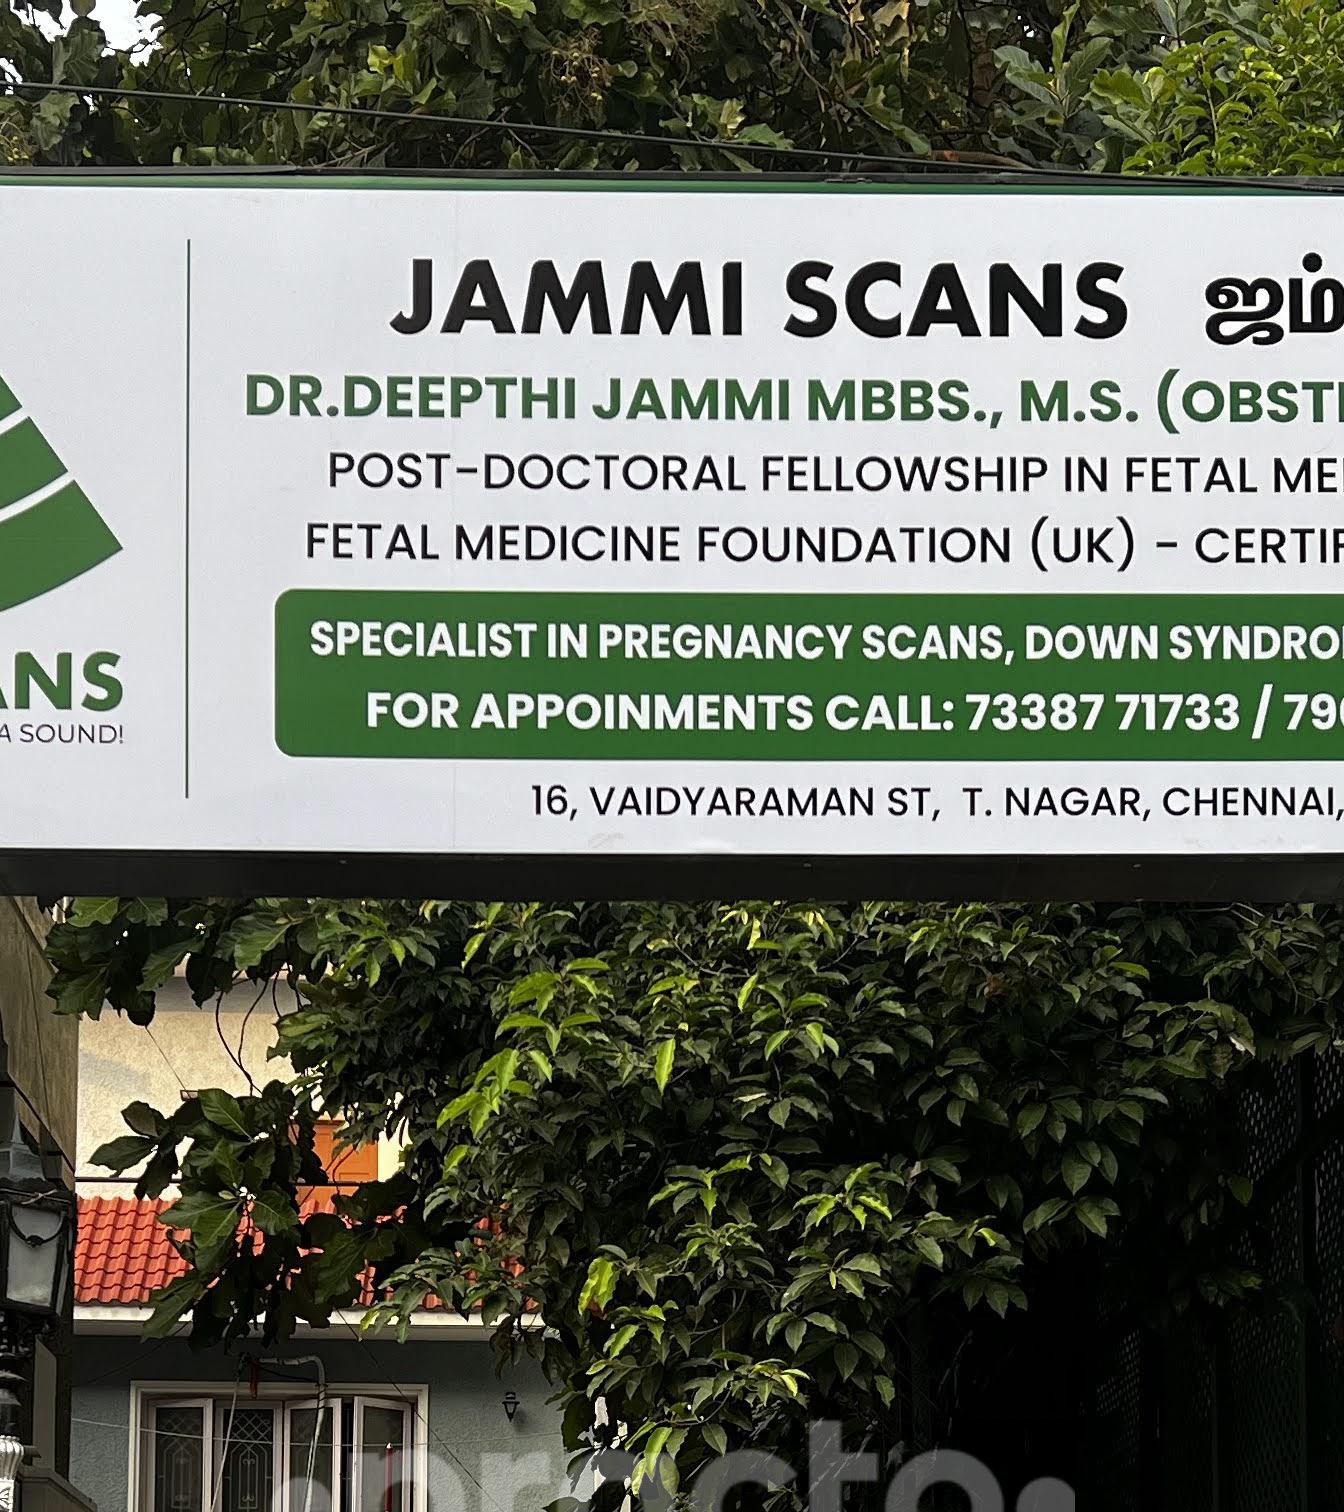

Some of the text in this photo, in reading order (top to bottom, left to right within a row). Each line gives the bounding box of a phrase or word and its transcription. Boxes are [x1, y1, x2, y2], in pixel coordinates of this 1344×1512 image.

[390, 259, 1127, 340] JAMMI SCANS
[247, 375, 575, 420] DR.DEEPTHI
[593, 378, 789, 420] JAMMI
[808, 379, 1002, 429] MBBS.,
[1021, 379, 1138, 422] M.S.
[330, 453, 746, 491] POST-DOCTORAL
[763, 455, 1047, 492] FELLOWSHIP
[1065, 457, 1107, 493] IN
[1127, 457, 1257, 493] FETAL
[308, 523, 439, 560] FETAL
[456, 524, 679, 562] MEDICINE
[699, 527, 1009, 563] FOUNDATION
[1032, 519, 1133, 573] (UK)
[311, 621, 537, 658] SPECIALIST
[548, 623, 587, 658] IN
[600, 623, 852, 660] PREGNANCY
[863, 624, 1014, 666] SCANS,
[1026, 625, 1158, 660] DOWN
[20, 724, 123, 744] SOUND!
[368, 693, 458, 729] FOR
[471, 694, 813, 731] APPOINMENTS
[826, 695, 953, 731] CALL:
[966, 694, 1104, 731] 73387
[1116, 694, 1239, 731] 71733
[1252, 684, 1273, 740] /
[532, 785, 577, 821] 16,
[590, 787, 873, 817] VAIDYARAMAN
[888, 788, 940, 822] ST,
[963, 788, 991, 817] T.
[1006, 787, 1150, 822] NAGAR,
[1163, 787, 1344, 822] CHENNAI,
